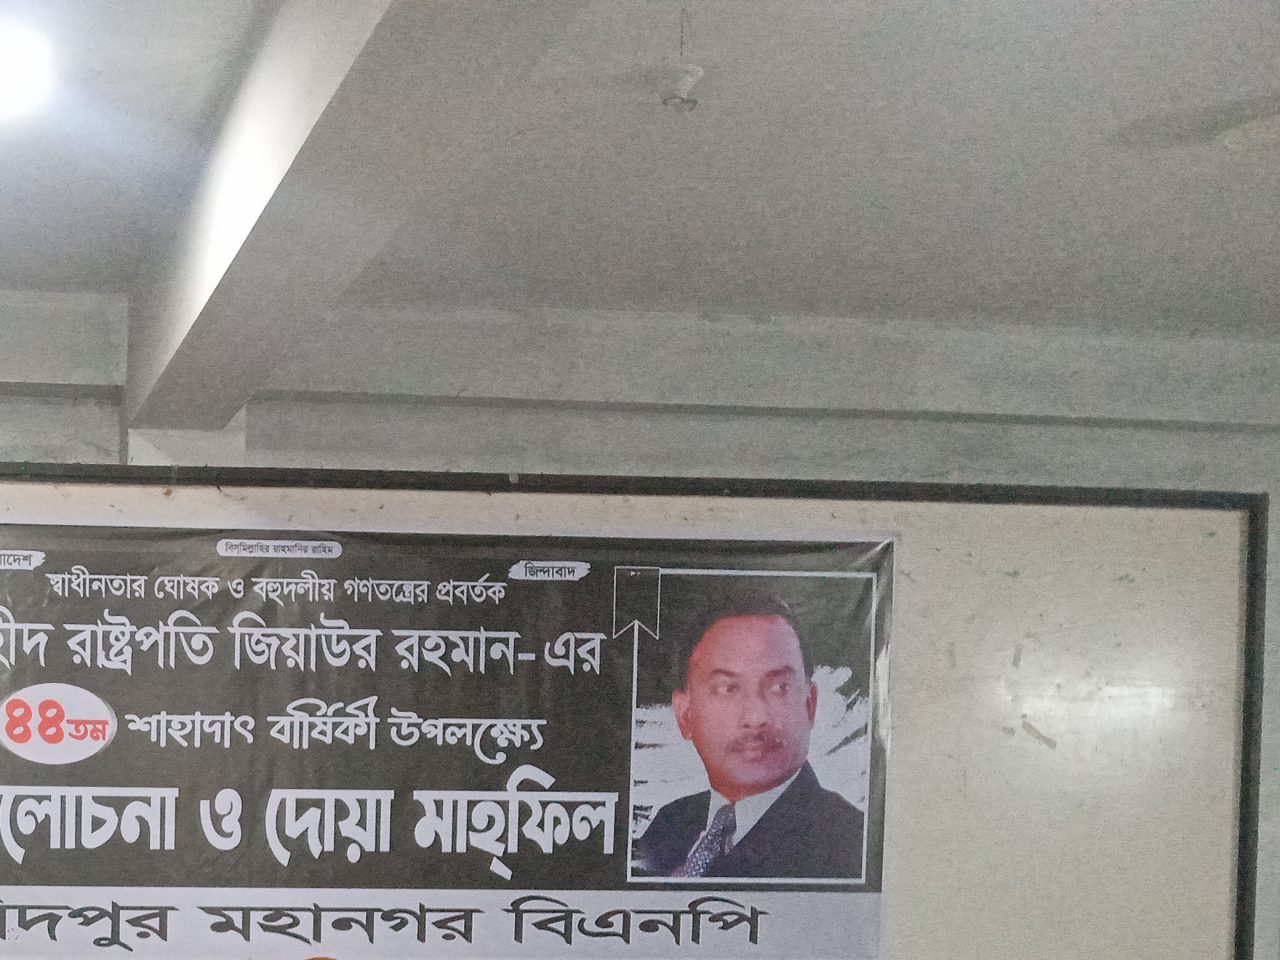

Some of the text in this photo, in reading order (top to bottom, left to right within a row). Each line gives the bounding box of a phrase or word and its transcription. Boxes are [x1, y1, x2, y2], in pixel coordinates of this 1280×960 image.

[45, 565, 507, 607] স্বাধীনতার ঘোষক ও বহুদলীয় গণতন্ত্রের প্রবর্তক
[524, 562, 577, 579] জিন্দাবাদ
[63, 608, 219, 676] রাষ্ট্রপতি
[227, 610, 383, 673] জিয়াউর
[125, 710, 255, 749] শাহাদাৎ
[267, 695, 380, 750] বার্ষিকী
[387, 707, 548, 766] উপলক্ষ্যে
[199, 787, 243, 851] ও
[265, 788, 395, 867] দোয়া
[198, 902, 481, 946] মহানগর
[503, 895, 768, 946] বিএনপি
